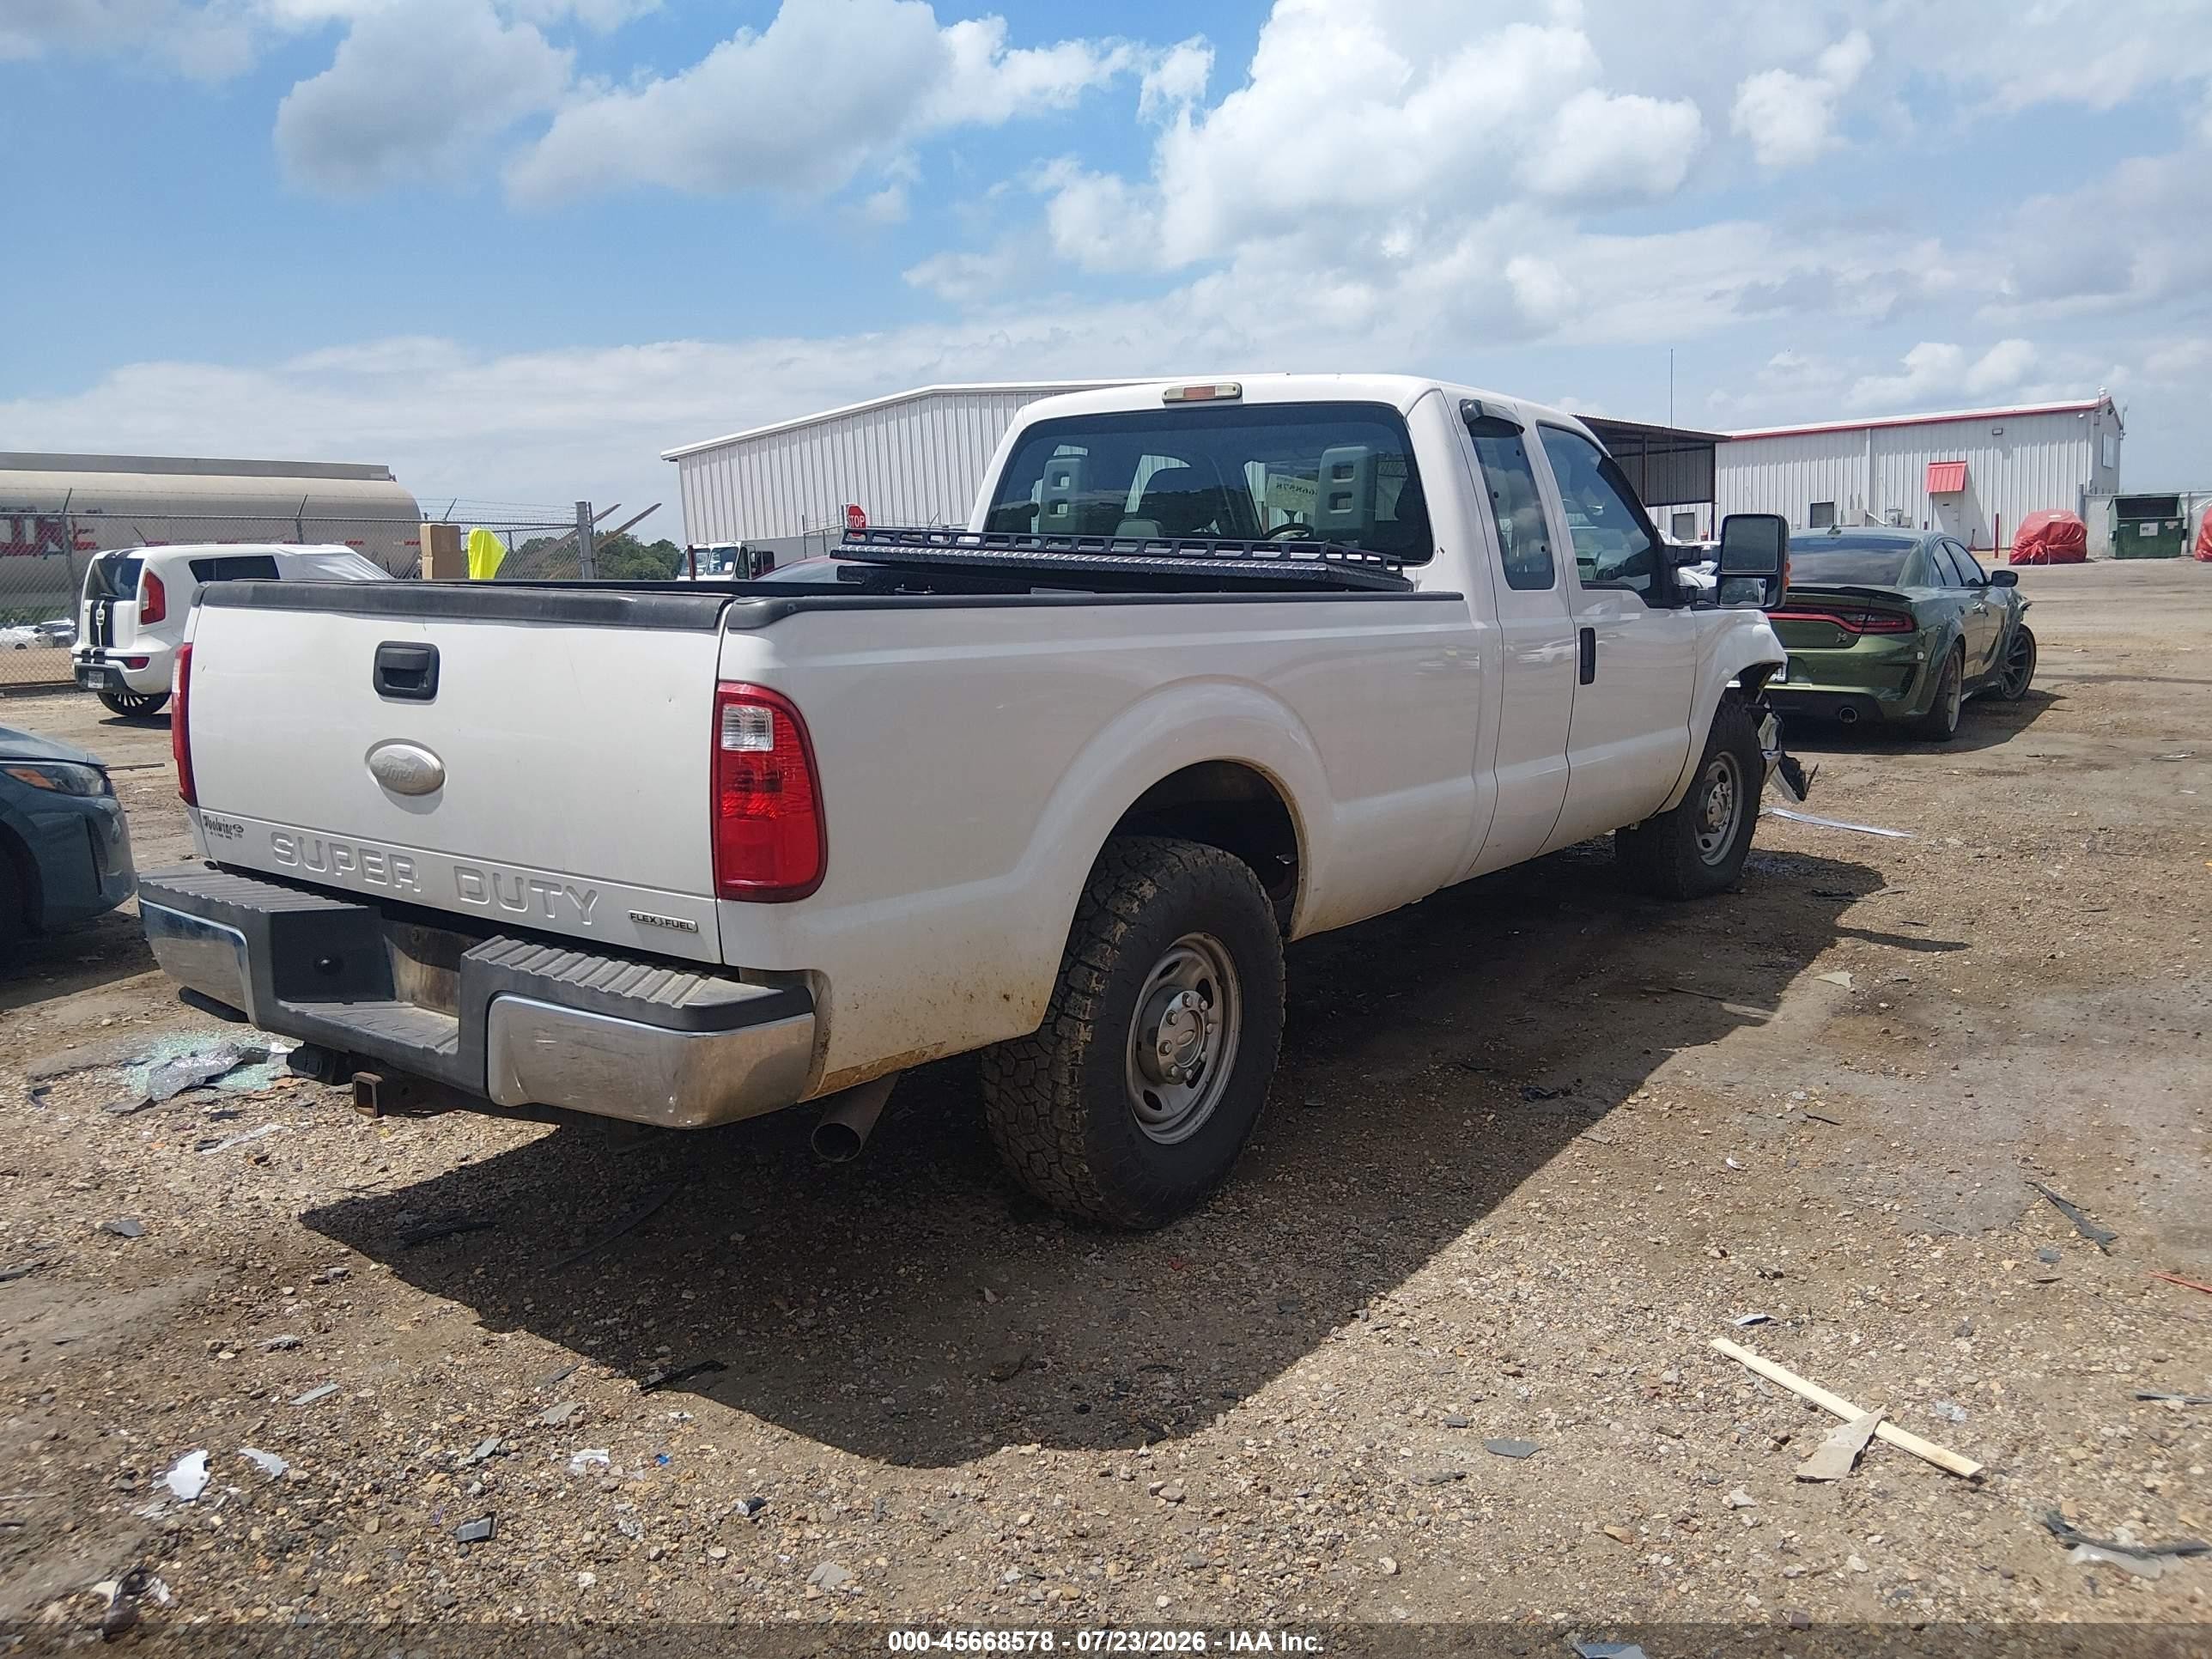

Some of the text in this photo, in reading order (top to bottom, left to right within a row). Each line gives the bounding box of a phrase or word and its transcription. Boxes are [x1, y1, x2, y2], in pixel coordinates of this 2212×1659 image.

[847, 514, 866, 528] STOP
[270, 831, 599, 926] SUPER DUTY
[630, 913, 694, 931] FLEX FUEL
